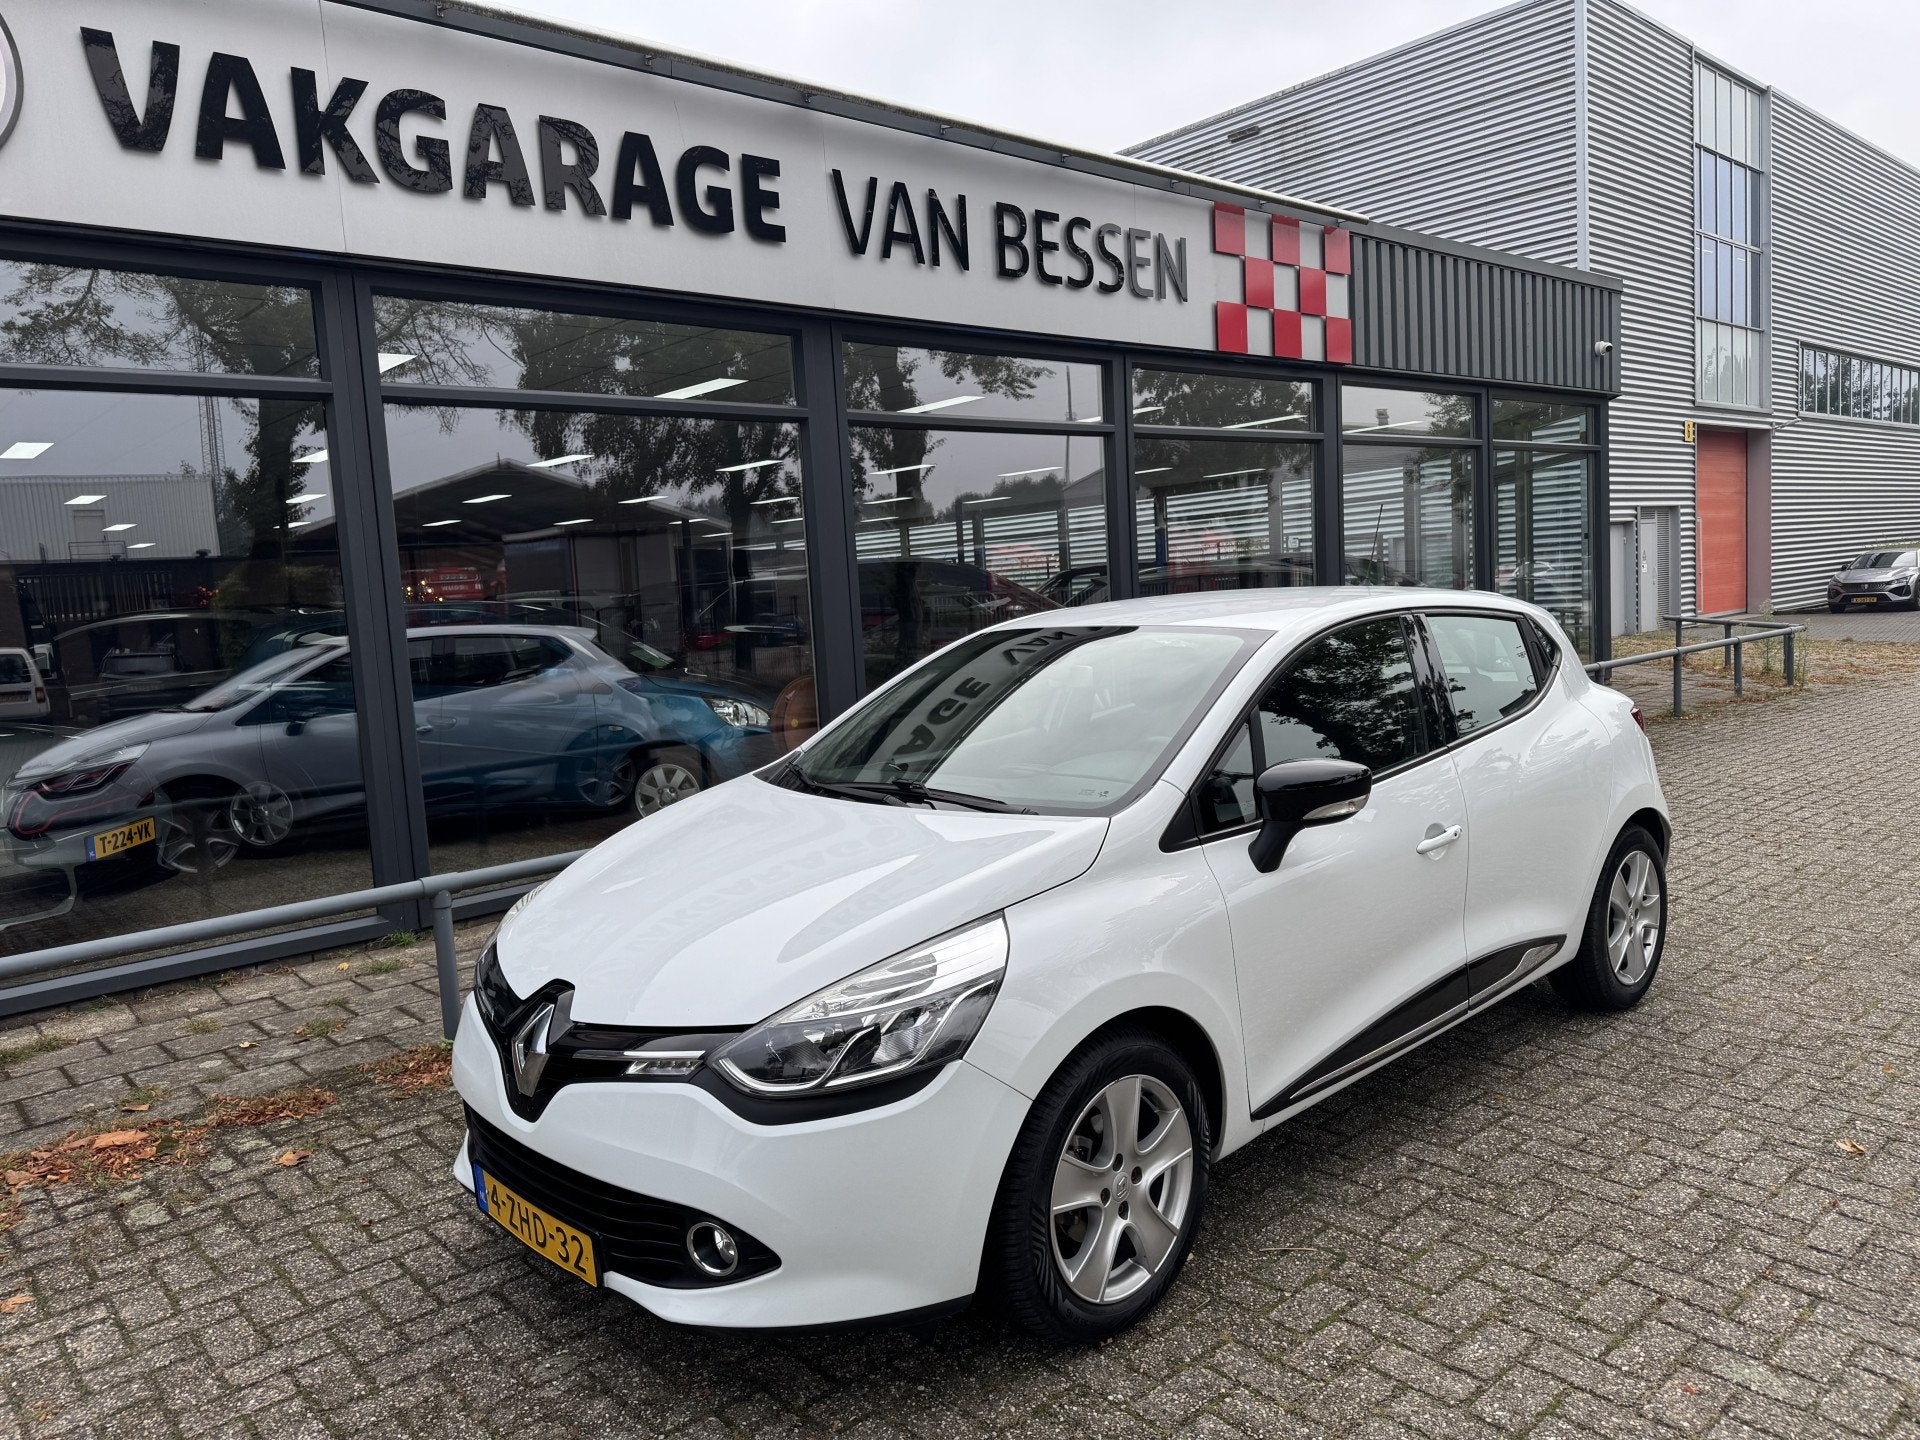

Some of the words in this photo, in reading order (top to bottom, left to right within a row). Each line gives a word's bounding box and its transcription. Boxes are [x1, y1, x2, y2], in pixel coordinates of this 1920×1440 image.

[80, 26, 787, 243] VAKGARAGE
[832, 169, 970, 271] VAN
[995, 200, 1188, 303] BESSEN
[99, 822, 152, 854] T-224-VK
[490, 1184, 587, 1274] 4-ZHD-32
